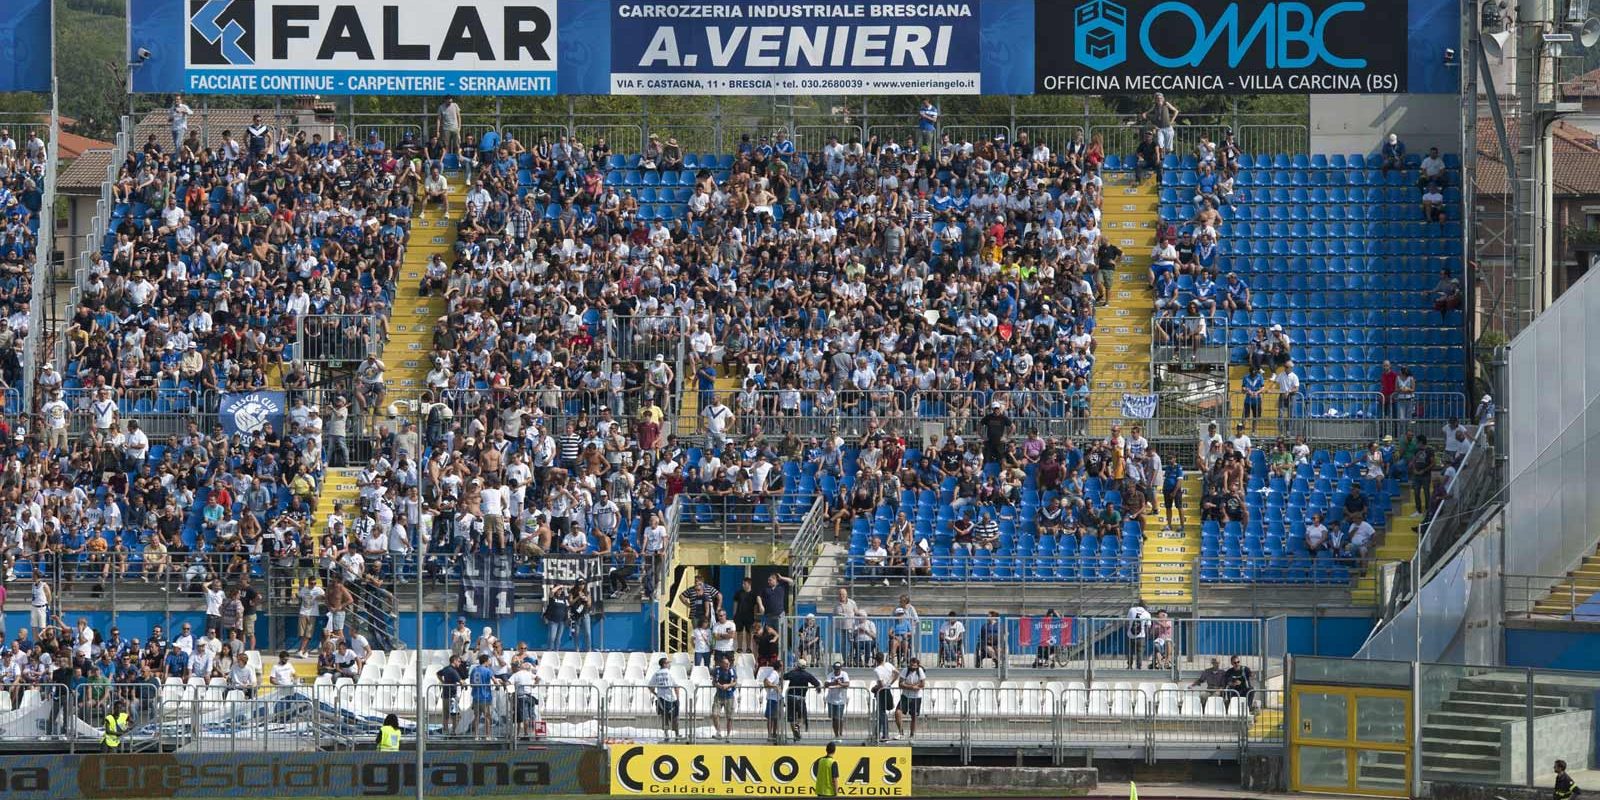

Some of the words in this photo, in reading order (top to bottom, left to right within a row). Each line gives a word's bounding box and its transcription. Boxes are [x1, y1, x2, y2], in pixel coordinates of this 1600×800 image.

[619, 4, 743, 18] CARROZZERIA
[748, 4, 865, 17] INDUSTRIALE
[870, 4, 972, 17] BRESCIANA
[271, 5, 552, 61] FALAR
[1139, 1, 1367, 69] OMBC
[638, 26, 953, 67] A.VENIERI
[190, 75, 257, 90] FACCIATE
[261, 75, 334, 91] CONTINUE
[347, 75, 445, 91] CARPENTERIE
[459, 76, 551, 92] SERRAMENTI
[616, 79, 634, 88] VIA
[636, 79, 645, 88] F.
[646, 79, 703, 90] CASTAGNA,
[707, 80, 718, 88] 11
[728, 79, 773, 89] BRESCIA
[782, 79, 799, 88] tel.
[801, 79, 863, 89] 030.2680039
[873, 79, 975, 90] www.venieriangelo.it
[1043, 75, 1121, 90] OFFICINA
[1125, 75, 1224, 90] MECCANICA
[1238, 75, 1284, 90] VILLA
[1288, 74, 1362, 90] CARCINA
[1366, 74, 1398, 92] (BS)
[227, 394, 259, 413] BRESCIA
[261, 397, 279, 413] CLUB
[649, 784, 716, 794] Caldaie
[725, 786, 735, 794] a
[744, 785, 902, 796] CONDENAZIONE
